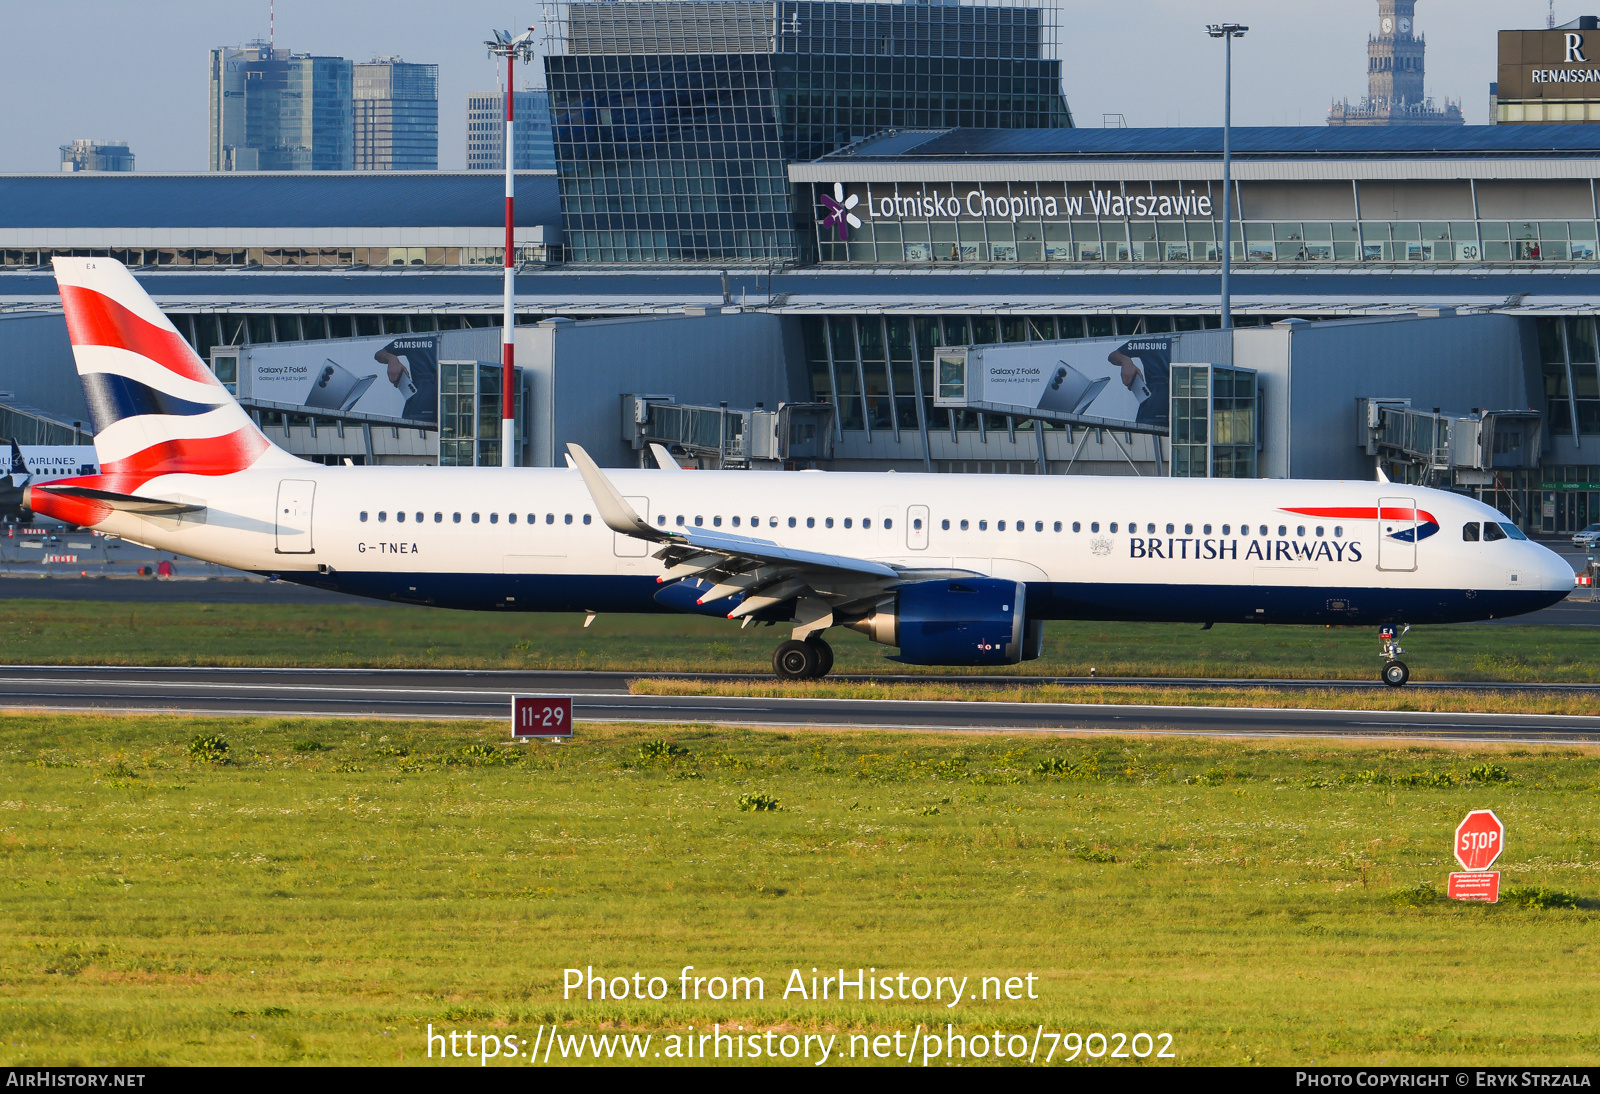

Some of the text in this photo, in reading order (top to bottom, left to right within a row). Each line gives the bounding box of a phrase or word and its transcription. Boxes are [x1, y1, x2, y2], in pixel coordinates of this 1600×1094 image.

[1564, 33, 1588, 63] R
[868, 190, 1213, 223] Lotnisko Chopina w Warszawie
[394, 341, 432, 349] SAMSUNG
[1127, 342, 1167, 350] SAMSUNG
[258, 366, 283, 374] Galaxy
[990, 367, 1016, 376] Galaxy
[1021, 367, 1041, 375] Fold6
[28, 457, 76, 465] AIRLINES
[358, 542, 419, 554] G-TNEA
[1130, 537, 1362, 562] BRITISH AIRWAYS
[521, 706, 564, 727] 11-29
[1461, 830, 1498, 851] STOP
